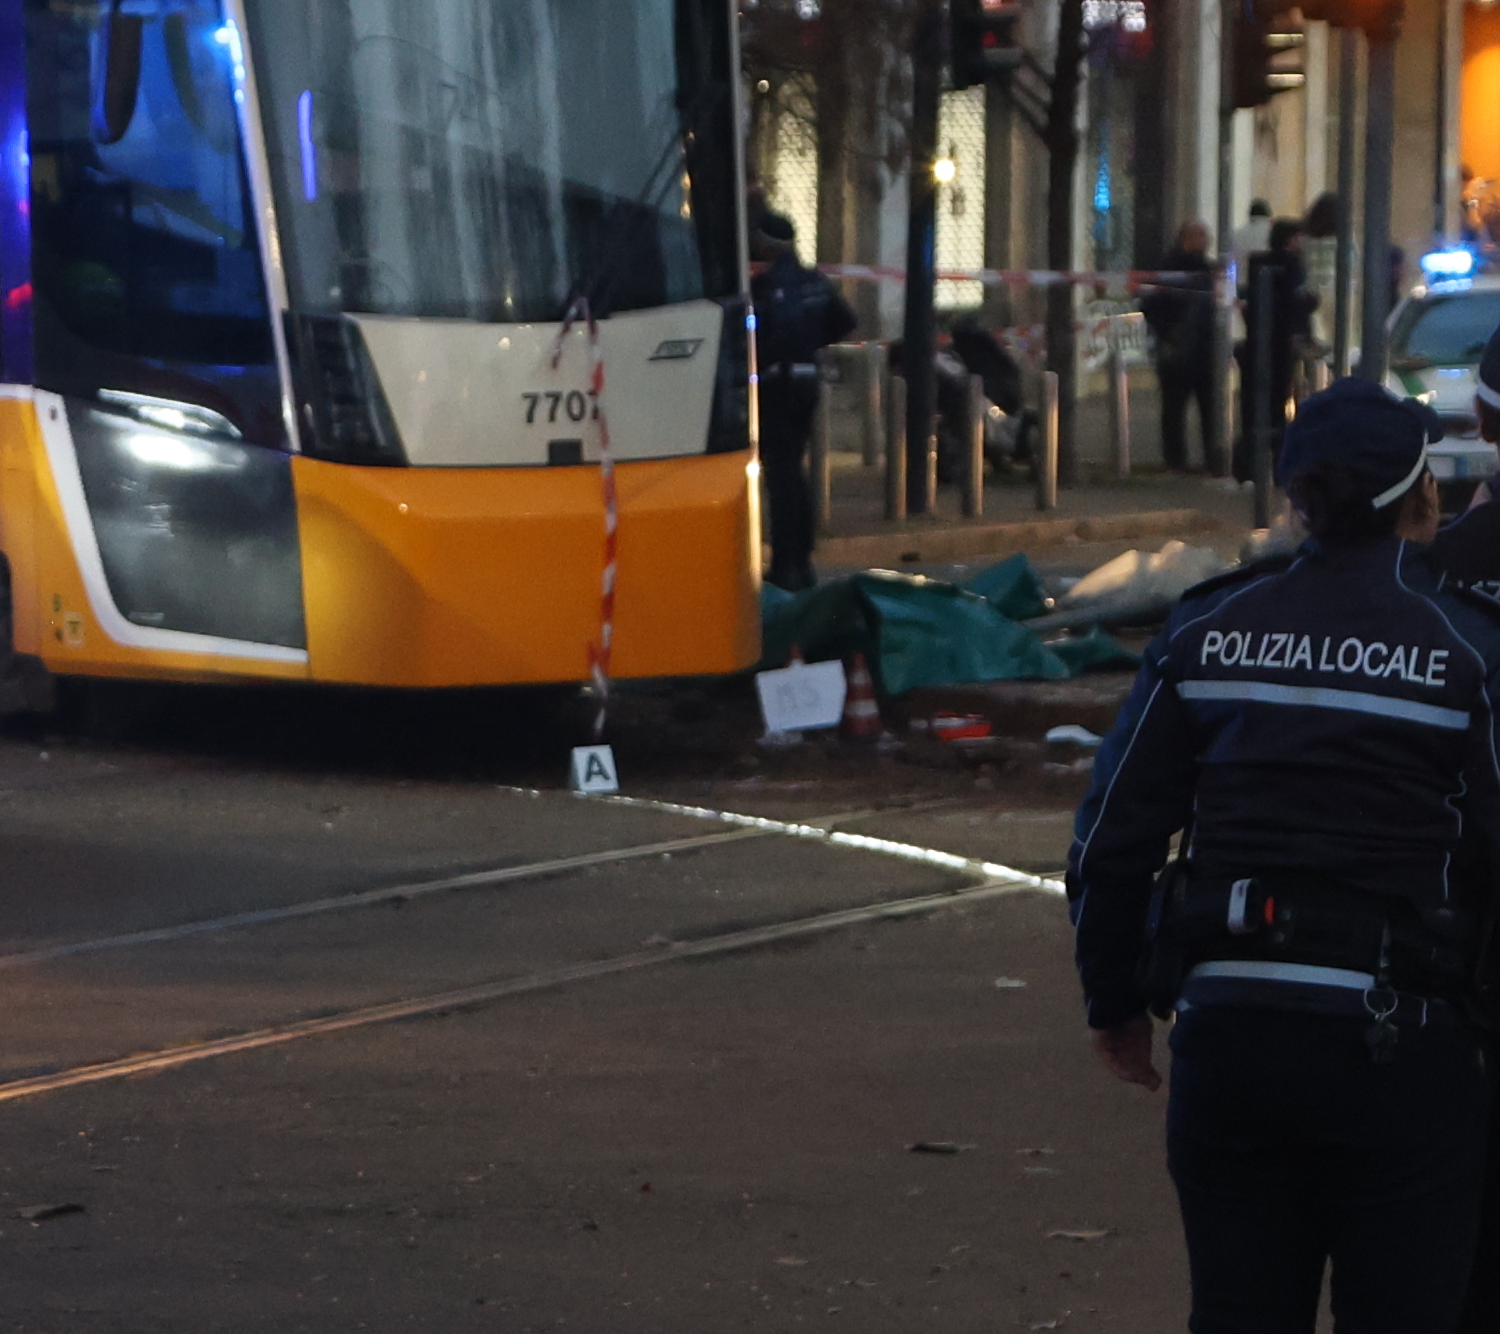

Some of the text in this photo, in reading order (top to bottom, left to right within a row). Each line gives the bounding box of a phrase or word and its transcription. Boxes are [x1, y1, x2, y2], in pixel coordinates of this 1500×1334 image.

[1200, 629, 1450, 688] POLIZIA LOCALE
[585, 752, 612, 783] A
